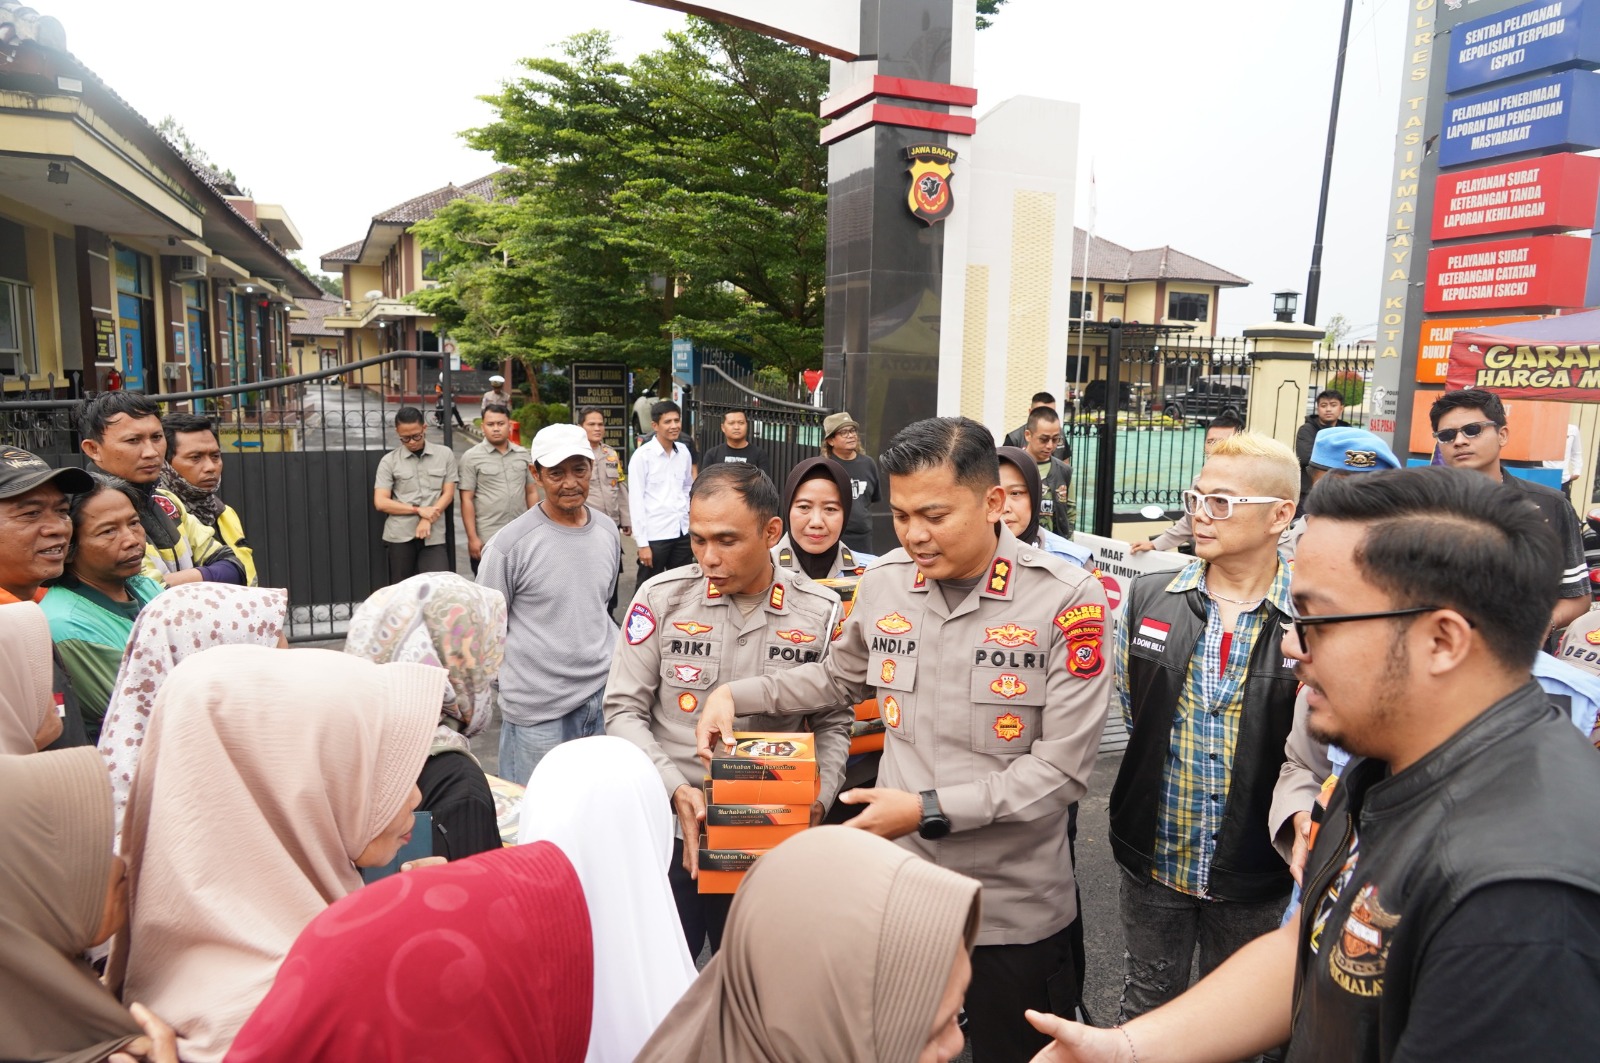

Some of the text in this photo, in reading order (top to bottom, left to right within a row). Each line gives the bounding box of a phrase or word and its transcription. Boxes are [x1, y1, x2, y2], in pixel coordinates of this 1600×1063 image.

[1465, 2, 1562, 45] SENTRA PELAYANAN
[1459, 19, 1565, 63] KEPOLISIAN TERPADU
[1490, 48, 1525, 70] (SPKT)
[1452, 84, 1561, 122] PELAYANAN PENERIMAAN
[1447, 101, 1563, 139] LAPORAN DAN PENGADUAN
[1471, 126, 1532, 150] MASYARAKAT
[911, 145, 956, 159] JAWA BARAT
[1389, 96, 1424, 281] TASIKMALAYA
[1455, 168, 1540, 195] PELAYANAN SURAT
[1450, 185, 1541, 211] KETERANGAN TANDA
[1443, 202, 1545, 228] LAPORAN KEHILANGAN
[1448, 248, 1529, 269] PELAYANAN SURAT
[1438, 264, 1537, 286] KETERANGAN CATATAN
[1442, 282, 1528, 301] KEPOLISIAN (SKCK)
[1380, 297, 1403, 358] KOTA
[1422, 345, 1446, 359] BUKU
[1476, 369, 1571, 388] HARGA
[587, 388, 614, 396] POLRES
[1101, 547, 1124, 561] MAAF
[1094, 560, 1111, 573] TUK
[1057, 605, 1102, 625] POLRES
[671, 640, 711, 657] RIKI
[871, 637, 1045, 669] ANDI.P POLRI
